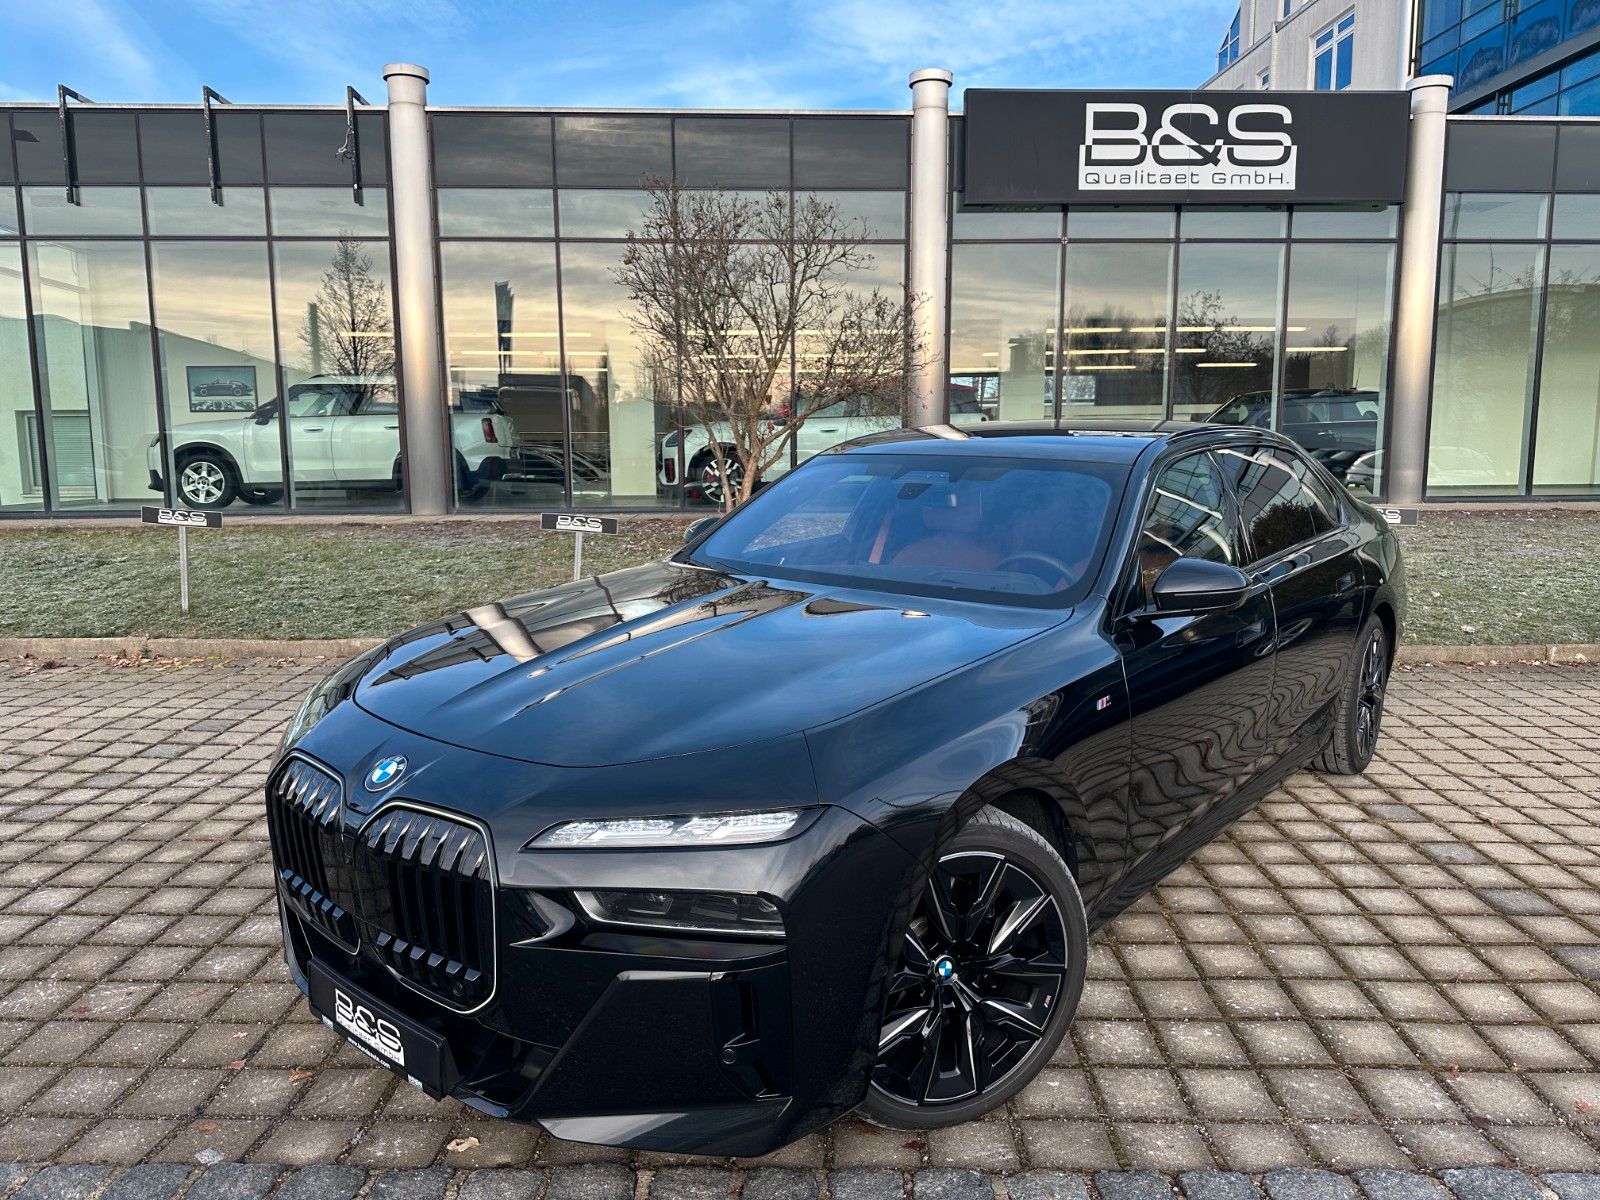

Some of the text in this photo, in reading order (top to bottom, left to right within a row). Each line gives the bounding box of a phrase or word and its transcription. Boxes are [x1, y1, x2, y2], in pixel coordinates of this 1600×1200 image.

[1085, 102, 1293, 167] B&S
[1084, 169, 1290, 185] Qualitaet GmbH.
[158, 508, 206, 523] B&S
[557, 515, 602, 529] B&S
[335, 988, 402, 1053] B&S
